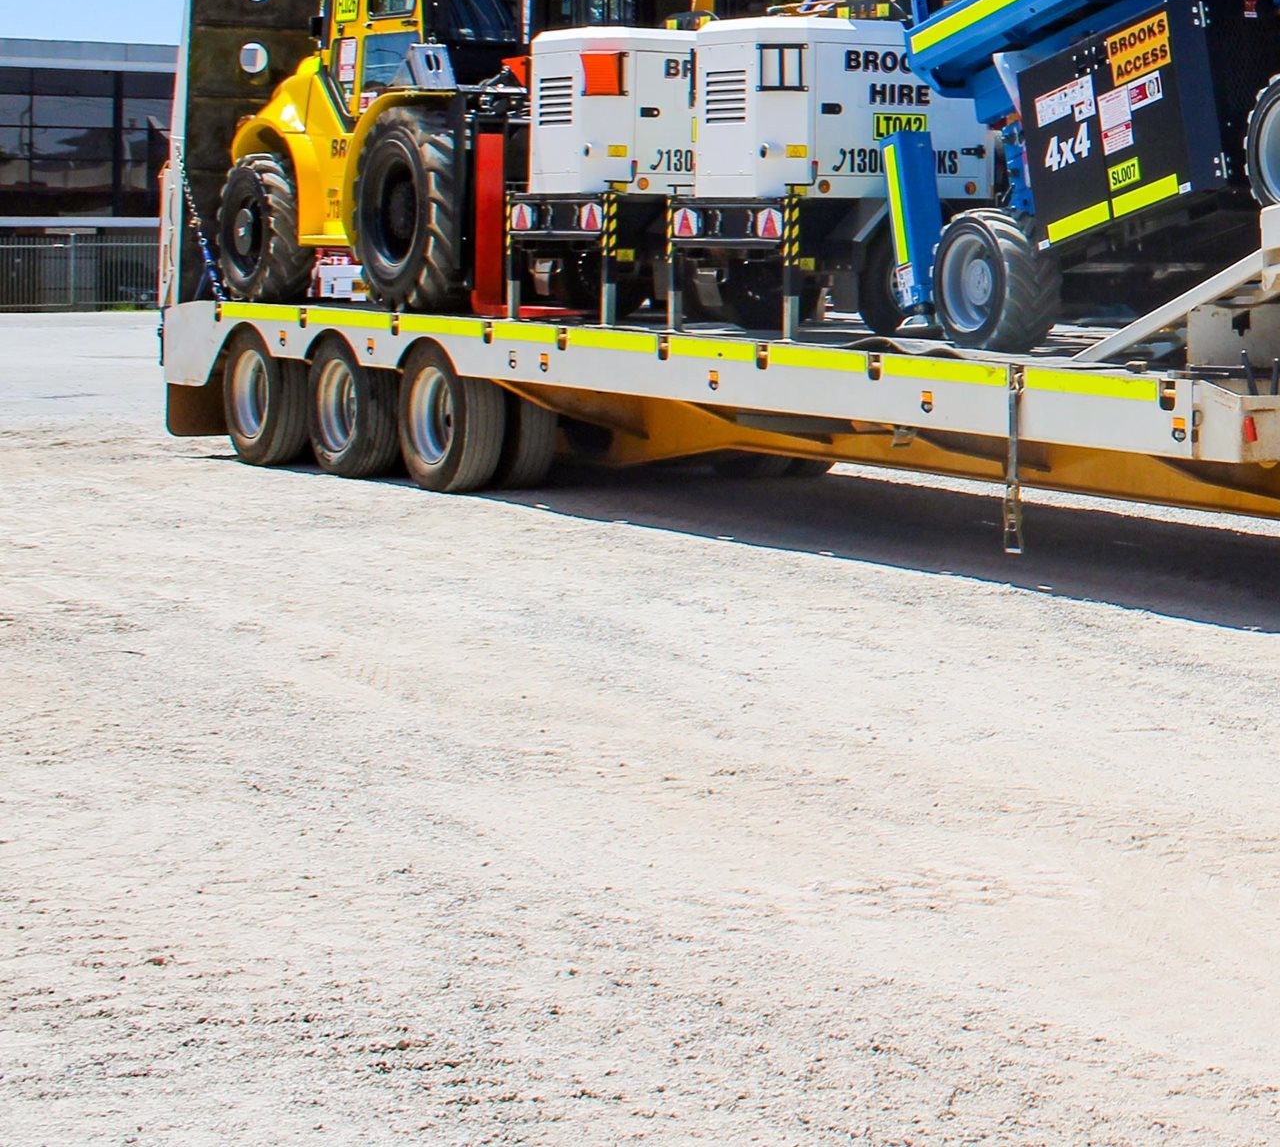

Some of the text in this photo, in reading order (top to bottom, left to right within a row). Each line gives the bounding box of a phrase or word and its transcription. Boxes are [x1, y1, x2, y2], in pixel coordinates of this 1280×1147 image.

[1109, 18, 1166, 57] BROOKS
[845, 49, 912, 74] BRO
[1115, 44, 1169, 81] ACCESS
[869, 83, 931, 106] HIRE
[875, 115, 923, 138] LT042
[1044, 121, 1091, 172] 4x4
[666, 150, 694, 172] 130
[1111, 163, 1138, 187] SL007
